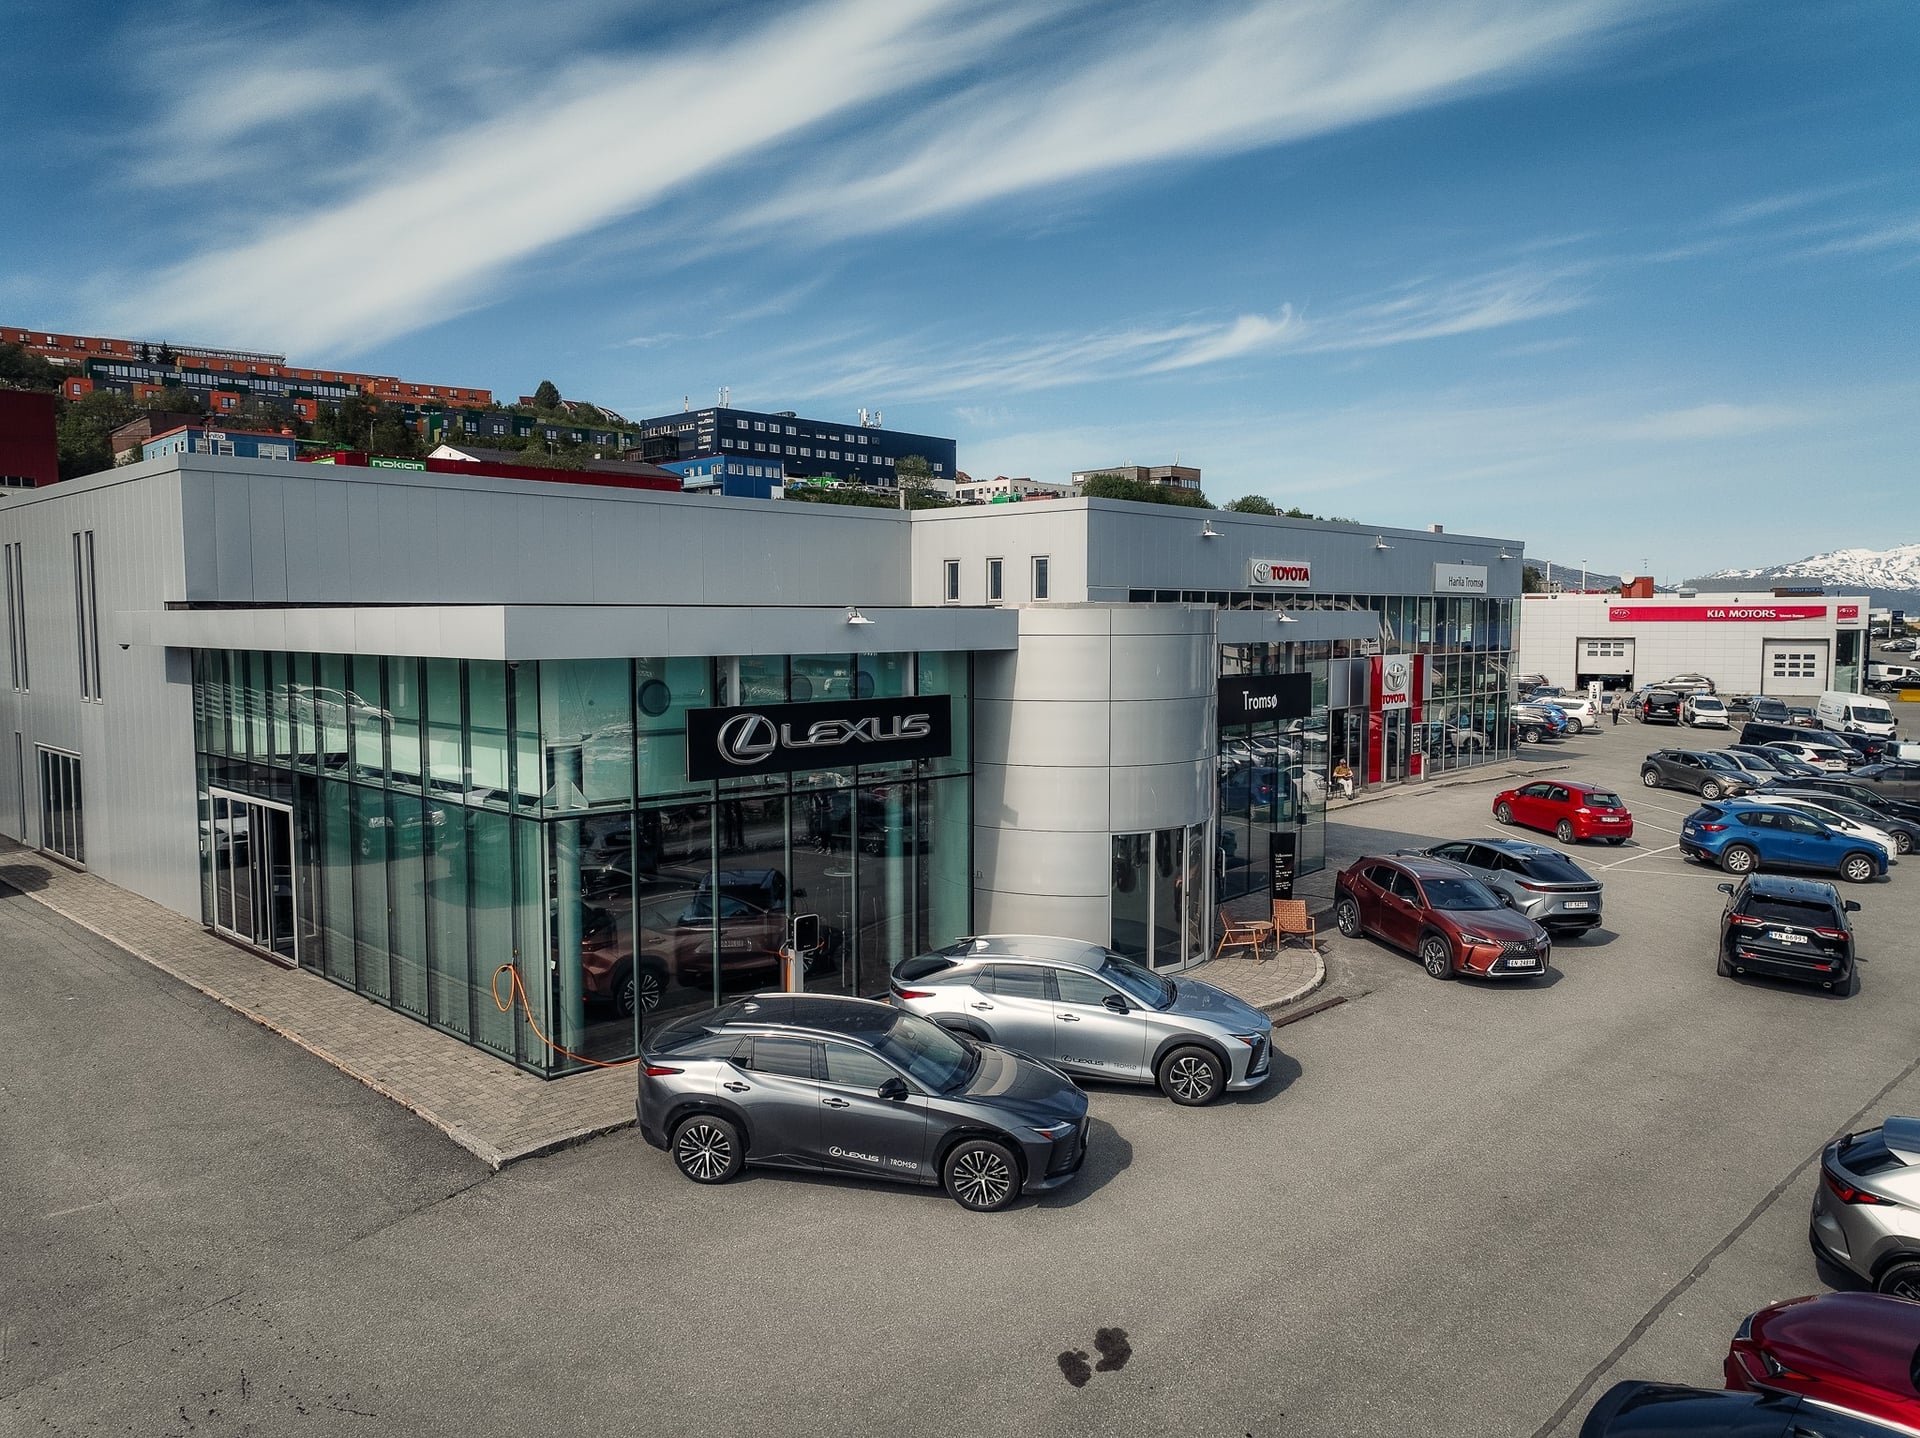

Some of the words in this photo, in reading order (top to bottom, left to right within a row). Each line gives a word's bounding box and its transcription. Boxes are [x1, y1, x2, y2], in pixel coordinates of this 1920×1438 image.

[1270, 565, 1310, 581] TOYOTA
[1706, 609, 1726, 618] KIA
[1728, 609, 1776, 618] MOTORS
[1242, 690, 1278, 710] Tromsø
[1382, 693, 1407, 705] TOYOTA
[781, 713, 931, 749] LEXUS
[1072, 1058, 1105, 1066] LEXUS
[842, 1150, 880, 1162] LEXUS
[889, 1158, 918, 1169] TROMSØ
